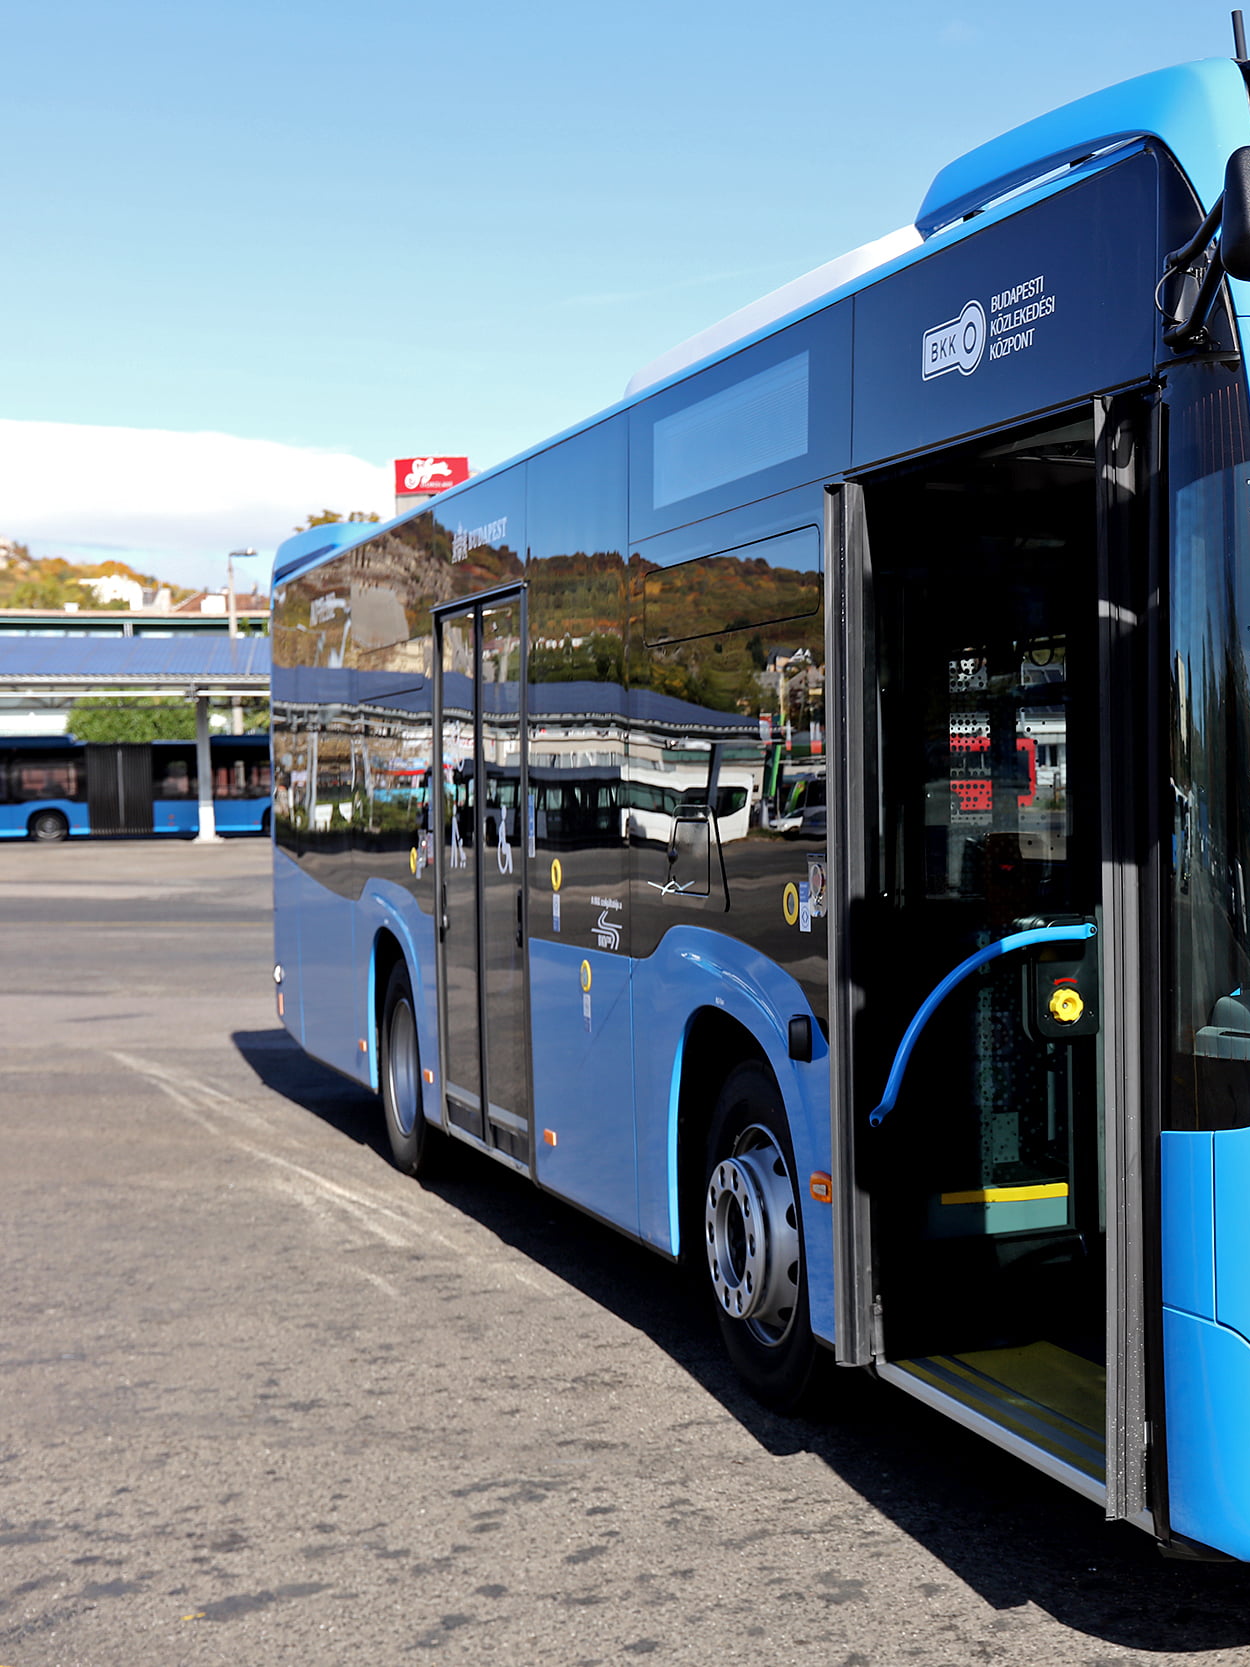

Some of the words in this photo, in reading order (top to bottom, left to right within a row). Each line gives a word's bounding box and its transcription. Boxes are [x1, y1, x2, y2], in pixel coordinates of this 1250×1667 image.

[991, 275, 1044, 313] BUDAPESTI
[990, 295, 1056, 337] KÖZLEKEDÉSI
[931, 334, 957, 363] BKK
[989, 327, 1036, 361] KÖZPONT
[468, 516, 508, 551] BUDAPEST
